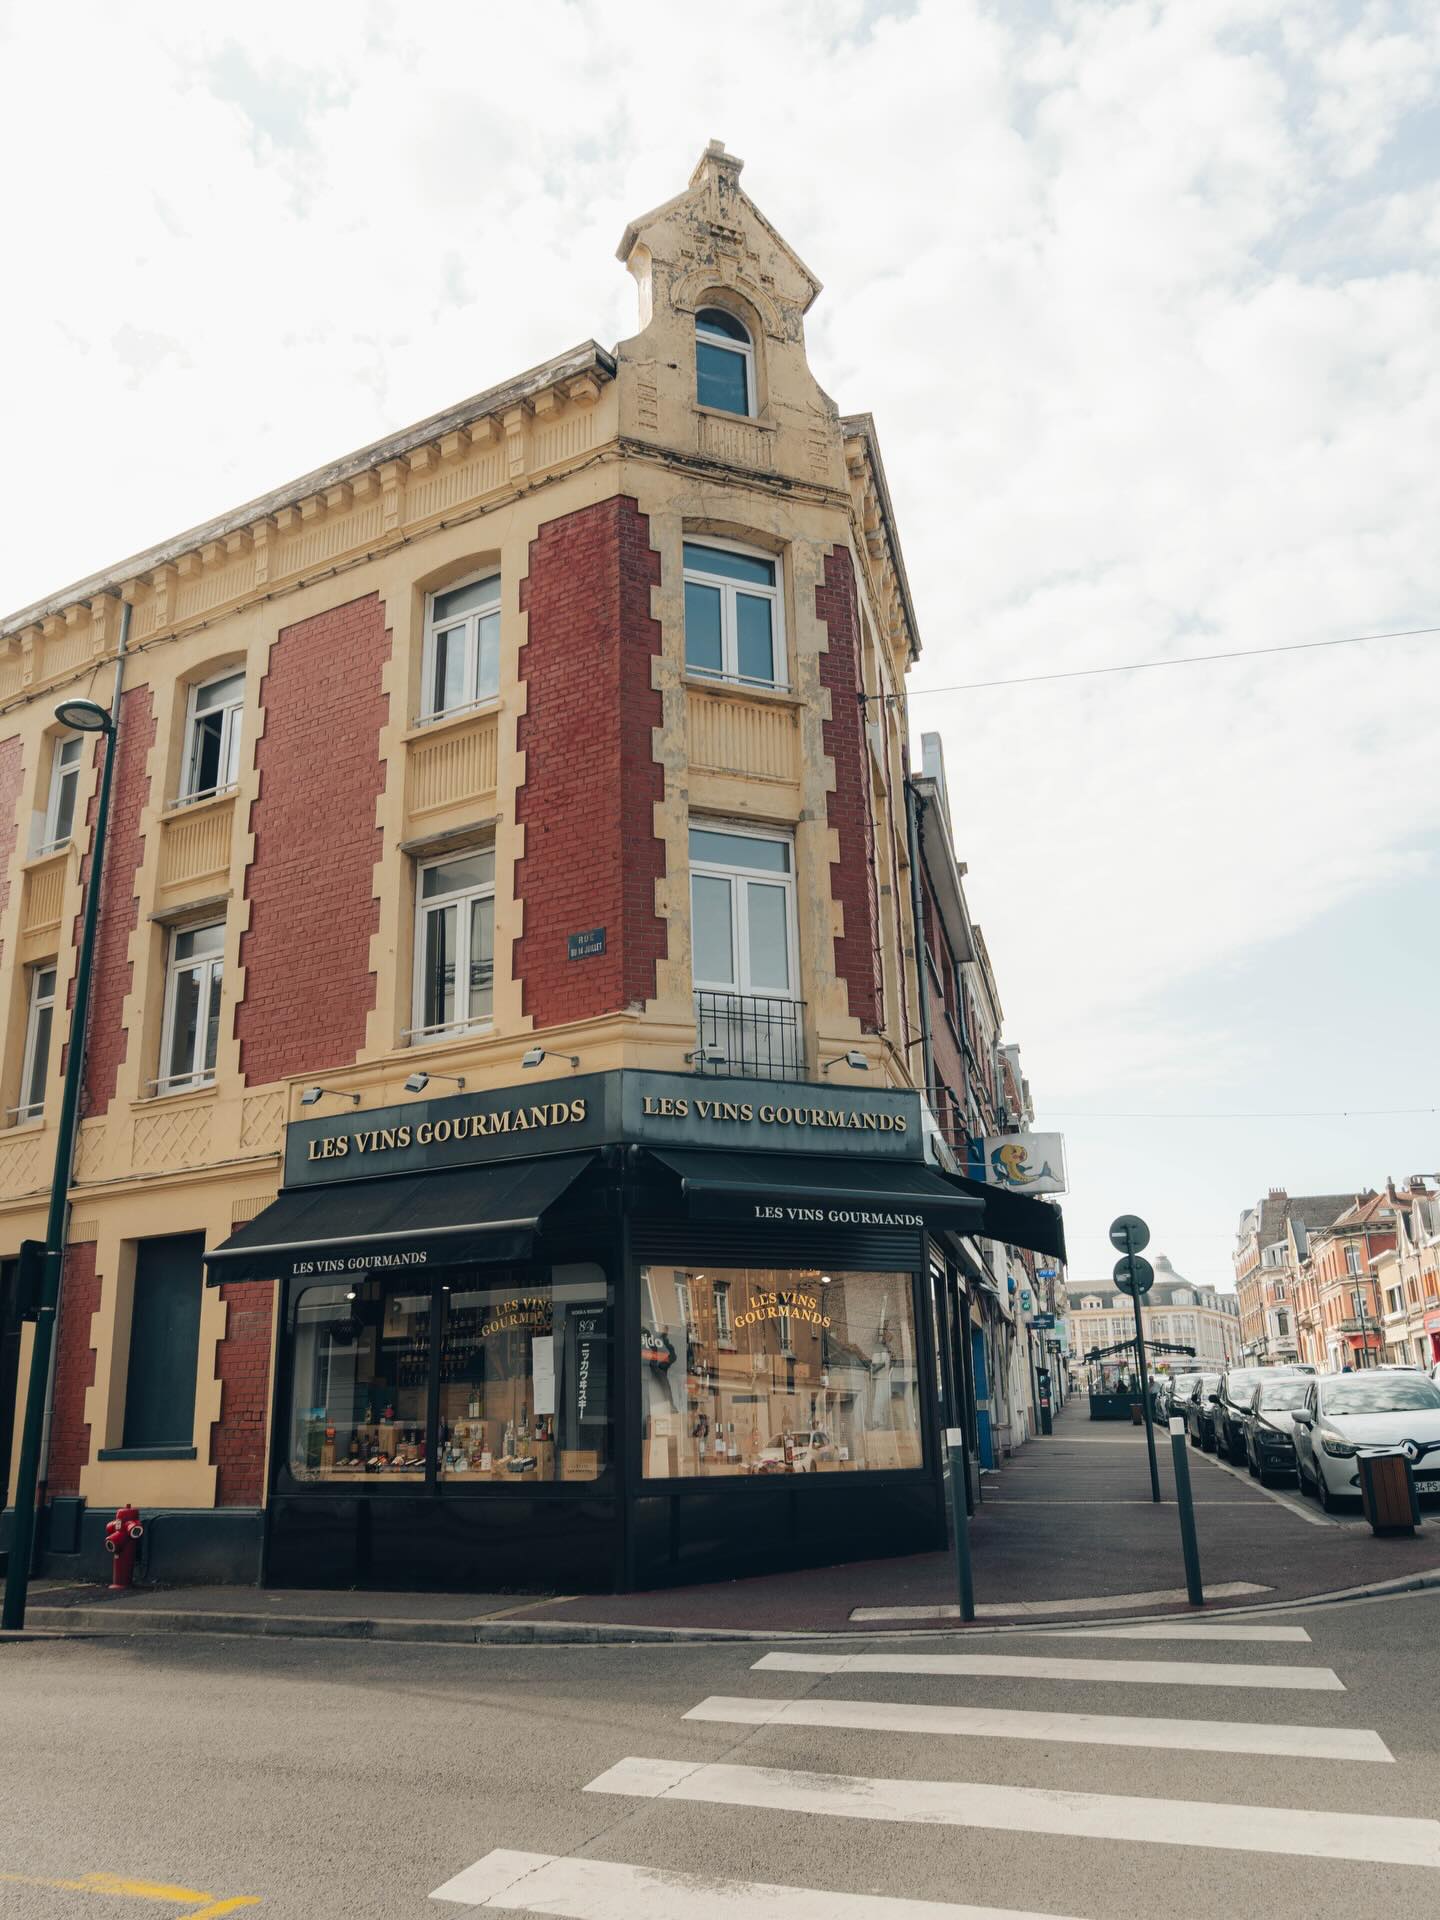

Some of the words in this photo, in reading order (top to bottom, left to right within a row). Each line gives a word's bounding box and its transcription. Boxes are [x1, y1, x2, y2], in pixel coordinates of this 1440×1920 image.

[643, 1096, 689, 1117] LES
[693, 1100, 753, 1121] VINS
[759, 1105, 907, 1132] GOURMANDS
[307, 1135, 350, 1161] LES
[354, 1125, 411, 1153] VINS
[416, 1099, 587, 1144] GOURMANDS
[755, 1206, 783, 1219] LES
[786, 1207, 824, 1221] VINS
[828, 1210, 924, 1226] GOURMANDS
[292, 1262, 314, 1274] LES
[316, 1259, 345, 1272] VINS
[347, 1251, 427, 1270] GOURMANDS
[495, 1299, 519, 1317] LES
[523, 1297, 553, 1312] VINS
[750, 1292, 777, 1308] LES
[781, 1291, 817, 1309] VINS
[481, 1311, 566, 1337] GOURM
[735, 1305, 831, 1328] GOURMANDS
